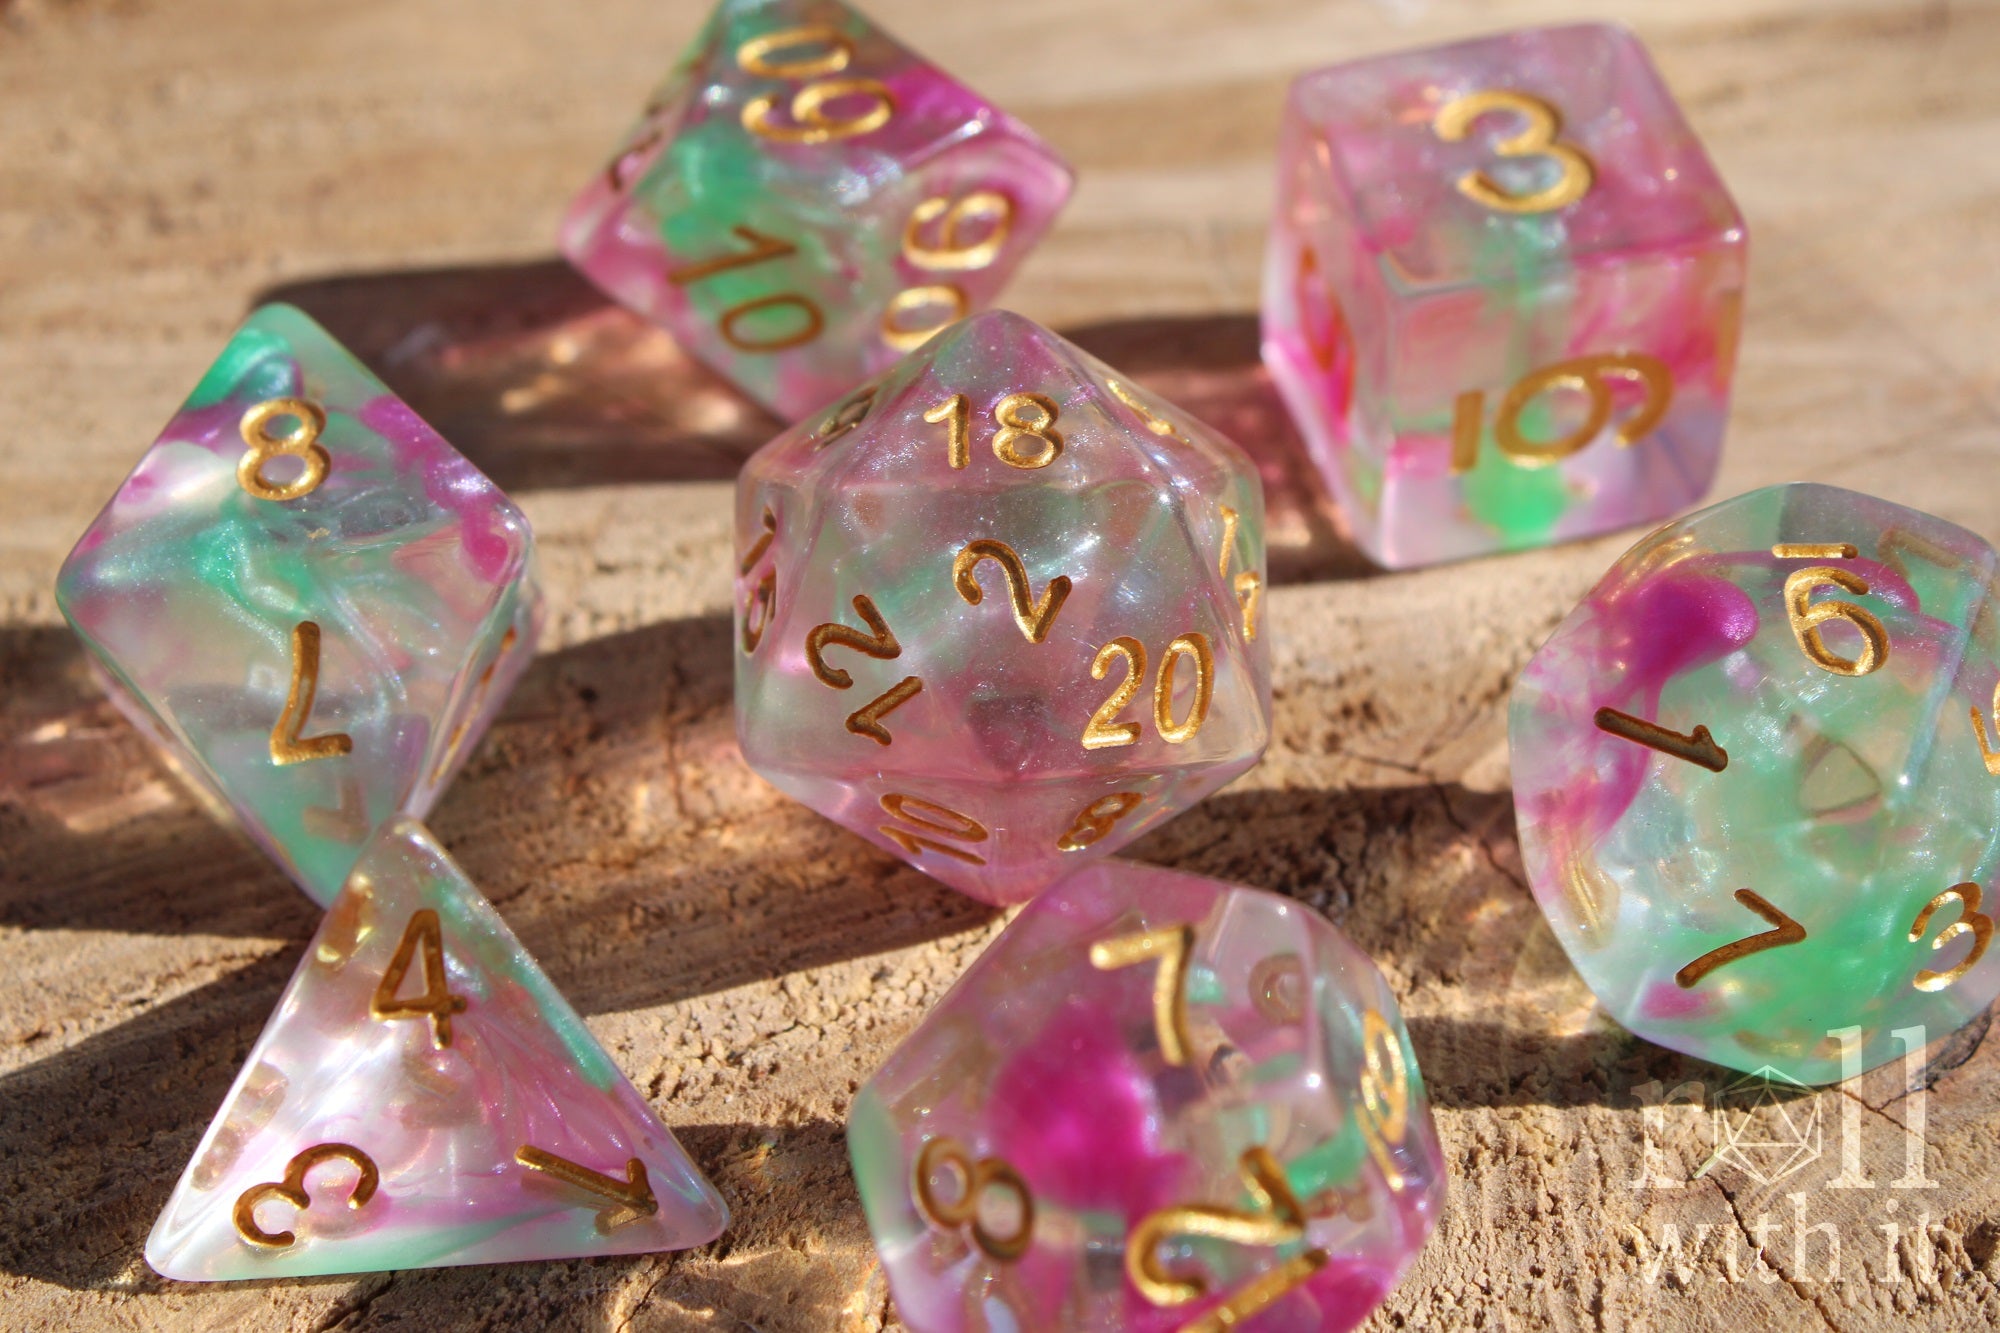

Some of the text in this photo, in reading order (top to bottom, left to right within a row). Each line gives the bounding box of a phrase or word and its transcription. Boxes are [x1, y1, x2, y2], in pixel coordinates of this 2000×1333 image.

[1435, 88, 1598, 214] 3
[668, 225, 825, 354] 10
[236, 397, 331, 501] 8
[923, 393, 1065, 470] 18
[952, 538, 1073, 644] 2
[270, 620, 353, 766] 7
[1081, 631, 1215, 750] 20
[1593, 705, 1729, 773] 1
[879, 792, 989, 866] 10
[371, 909, 468, 1050] 4
[1675, 887, 1807, 988] 7
[1908, 881, 1995, 993] 3
[1090, 924, 1196, 1067] 7
[232, 1142, 380, 1248] 3
[513, 1144, 659, 1218] 1
[914, 1136, 1034, 1265] 8
